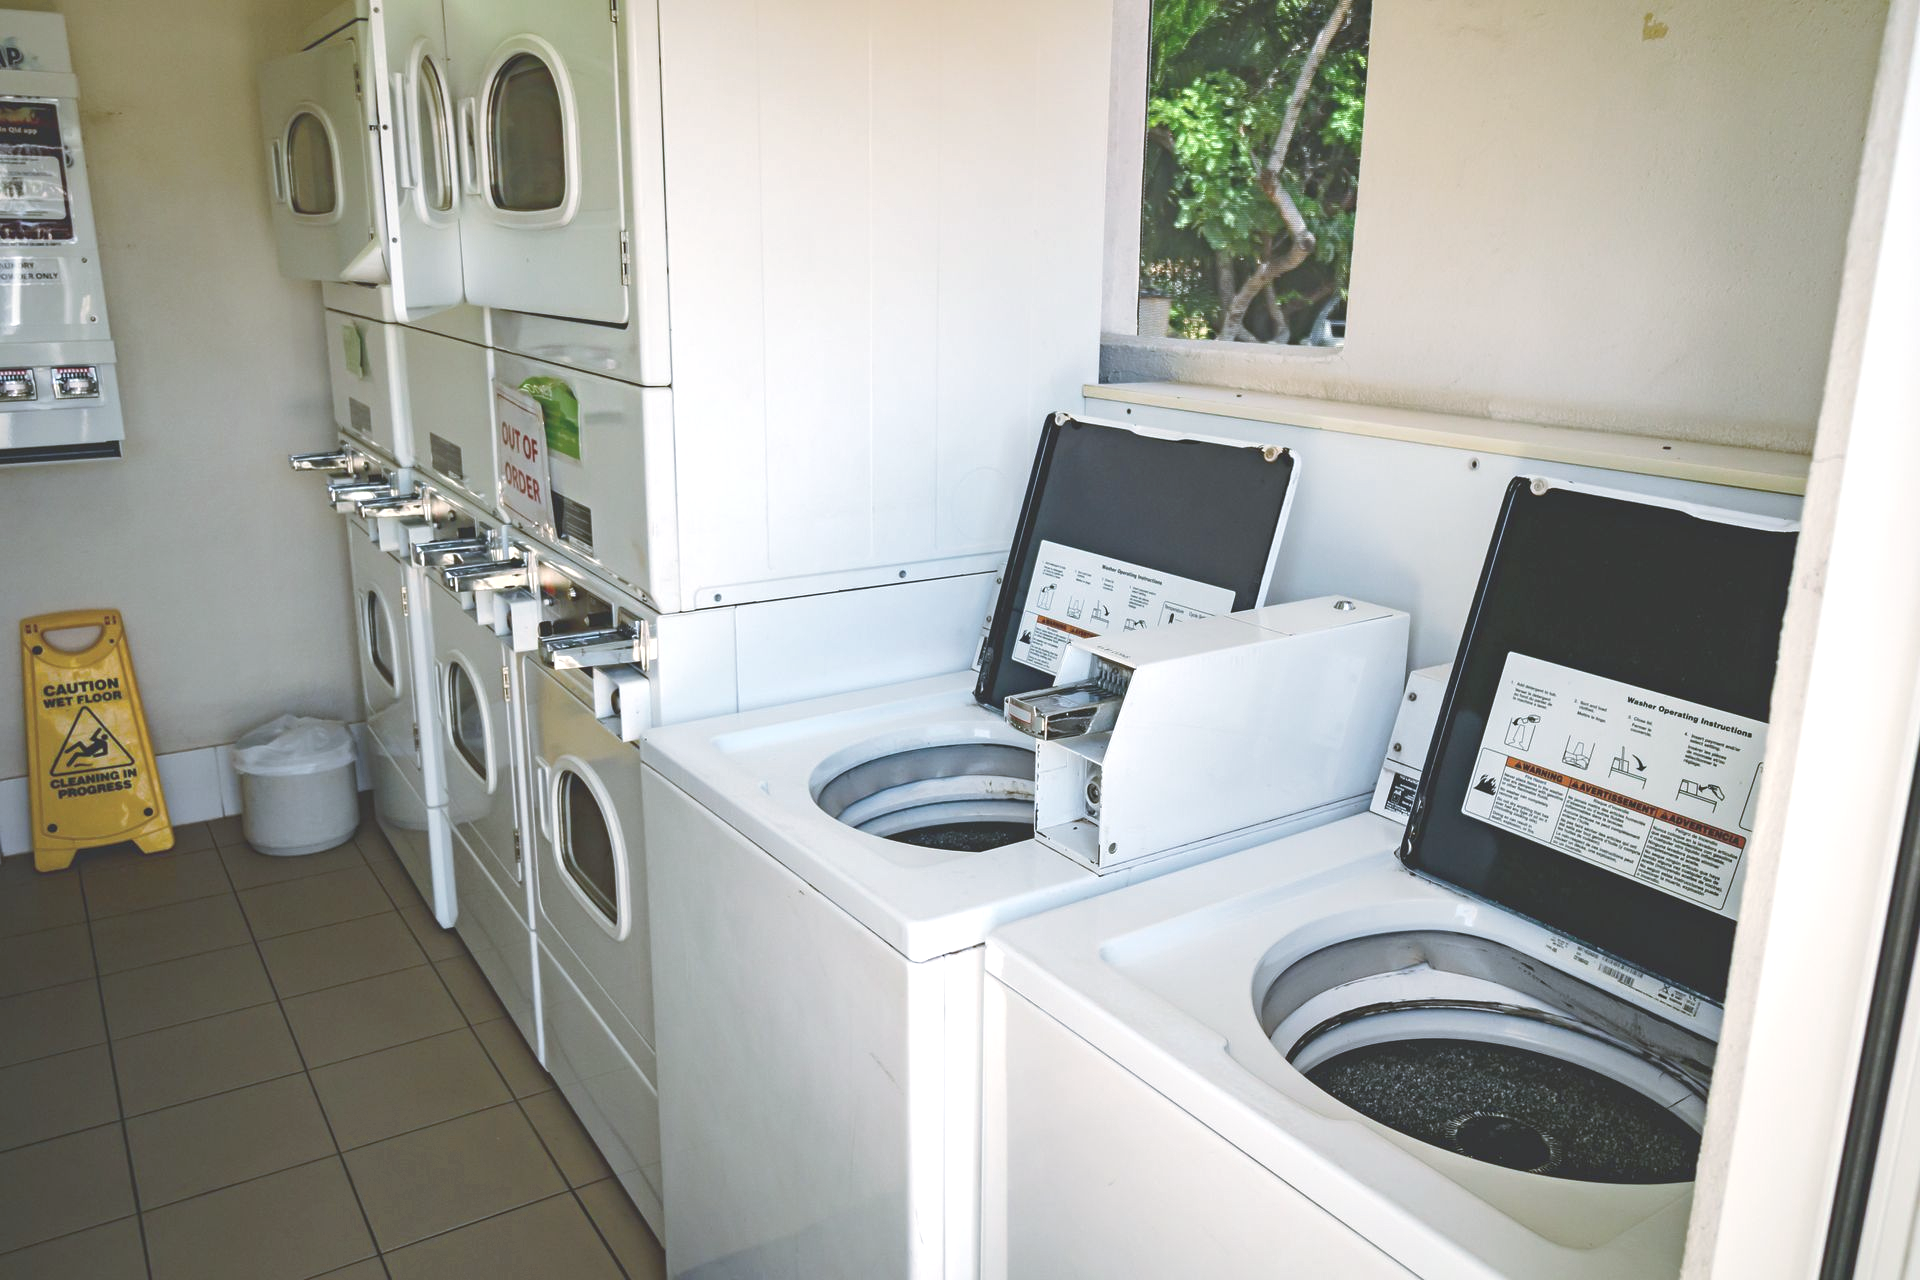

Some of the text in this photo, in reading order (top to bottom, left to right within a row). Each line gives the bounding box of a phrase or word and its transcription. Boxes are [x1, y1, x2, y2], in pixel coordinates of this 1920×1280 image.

[35, 272, 59, 280] ONLY
[501, 421, 539, 464] OUT OF
[504, 461, 542, 505] ORDER
[43, 678, 120, 697] CAUTION
[44, 691, 123, 709] WET FLOOR
[1628, 697, 1752, 738] Washer Operating Instructions
[50, 768, 137, 790] CLEANING IN
[1523, 763, 1563, 783] WARNING
[58, 780, 132, 799] PROGRESS
[1580, 784, 1657, 815] AVERTISSEMENT
[1669, 815, 1739, 845] ADVERTENCIA
